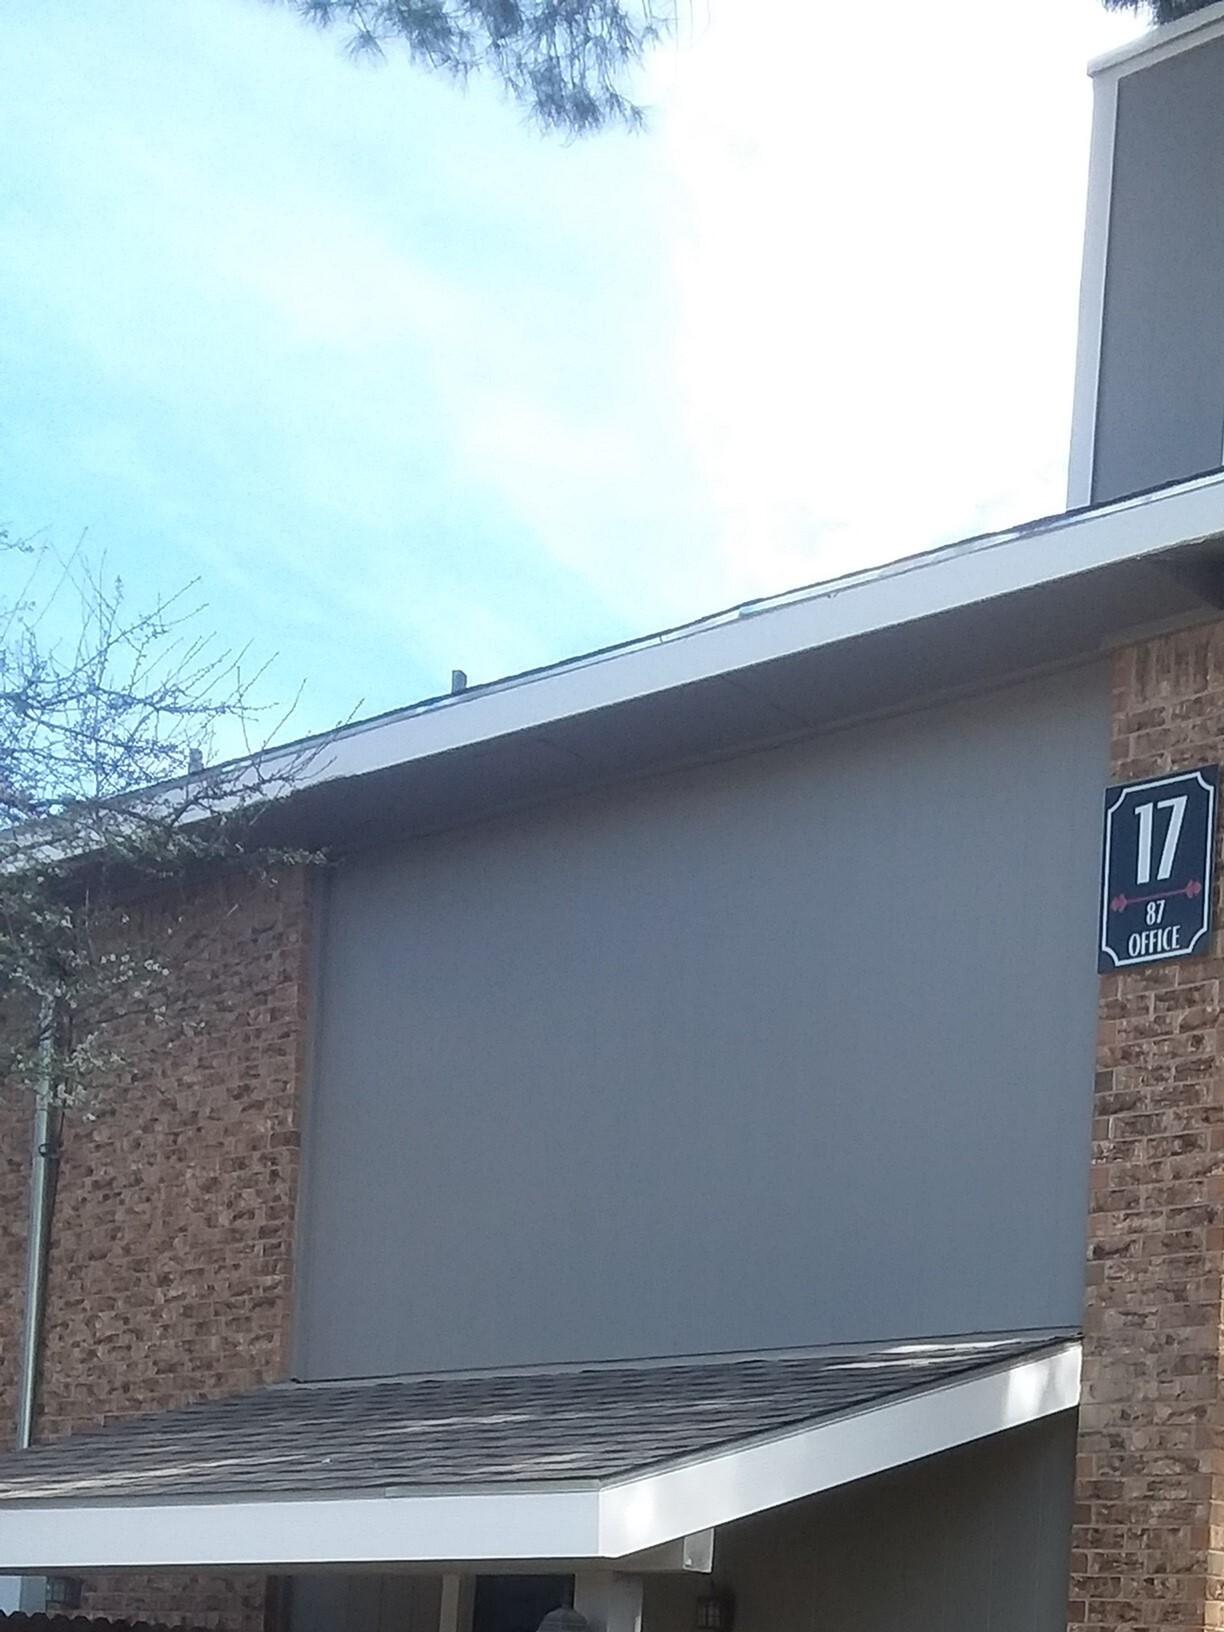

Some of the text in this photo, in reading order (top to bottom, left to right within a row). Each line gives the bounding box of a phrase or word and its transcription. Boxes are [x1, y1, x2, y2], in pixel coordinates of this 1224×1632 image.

[1134, 795, 1189, 885] 17
[1145, 899, 1166, 925] 87
[1128, 925, 1181, 957] OFFICE
